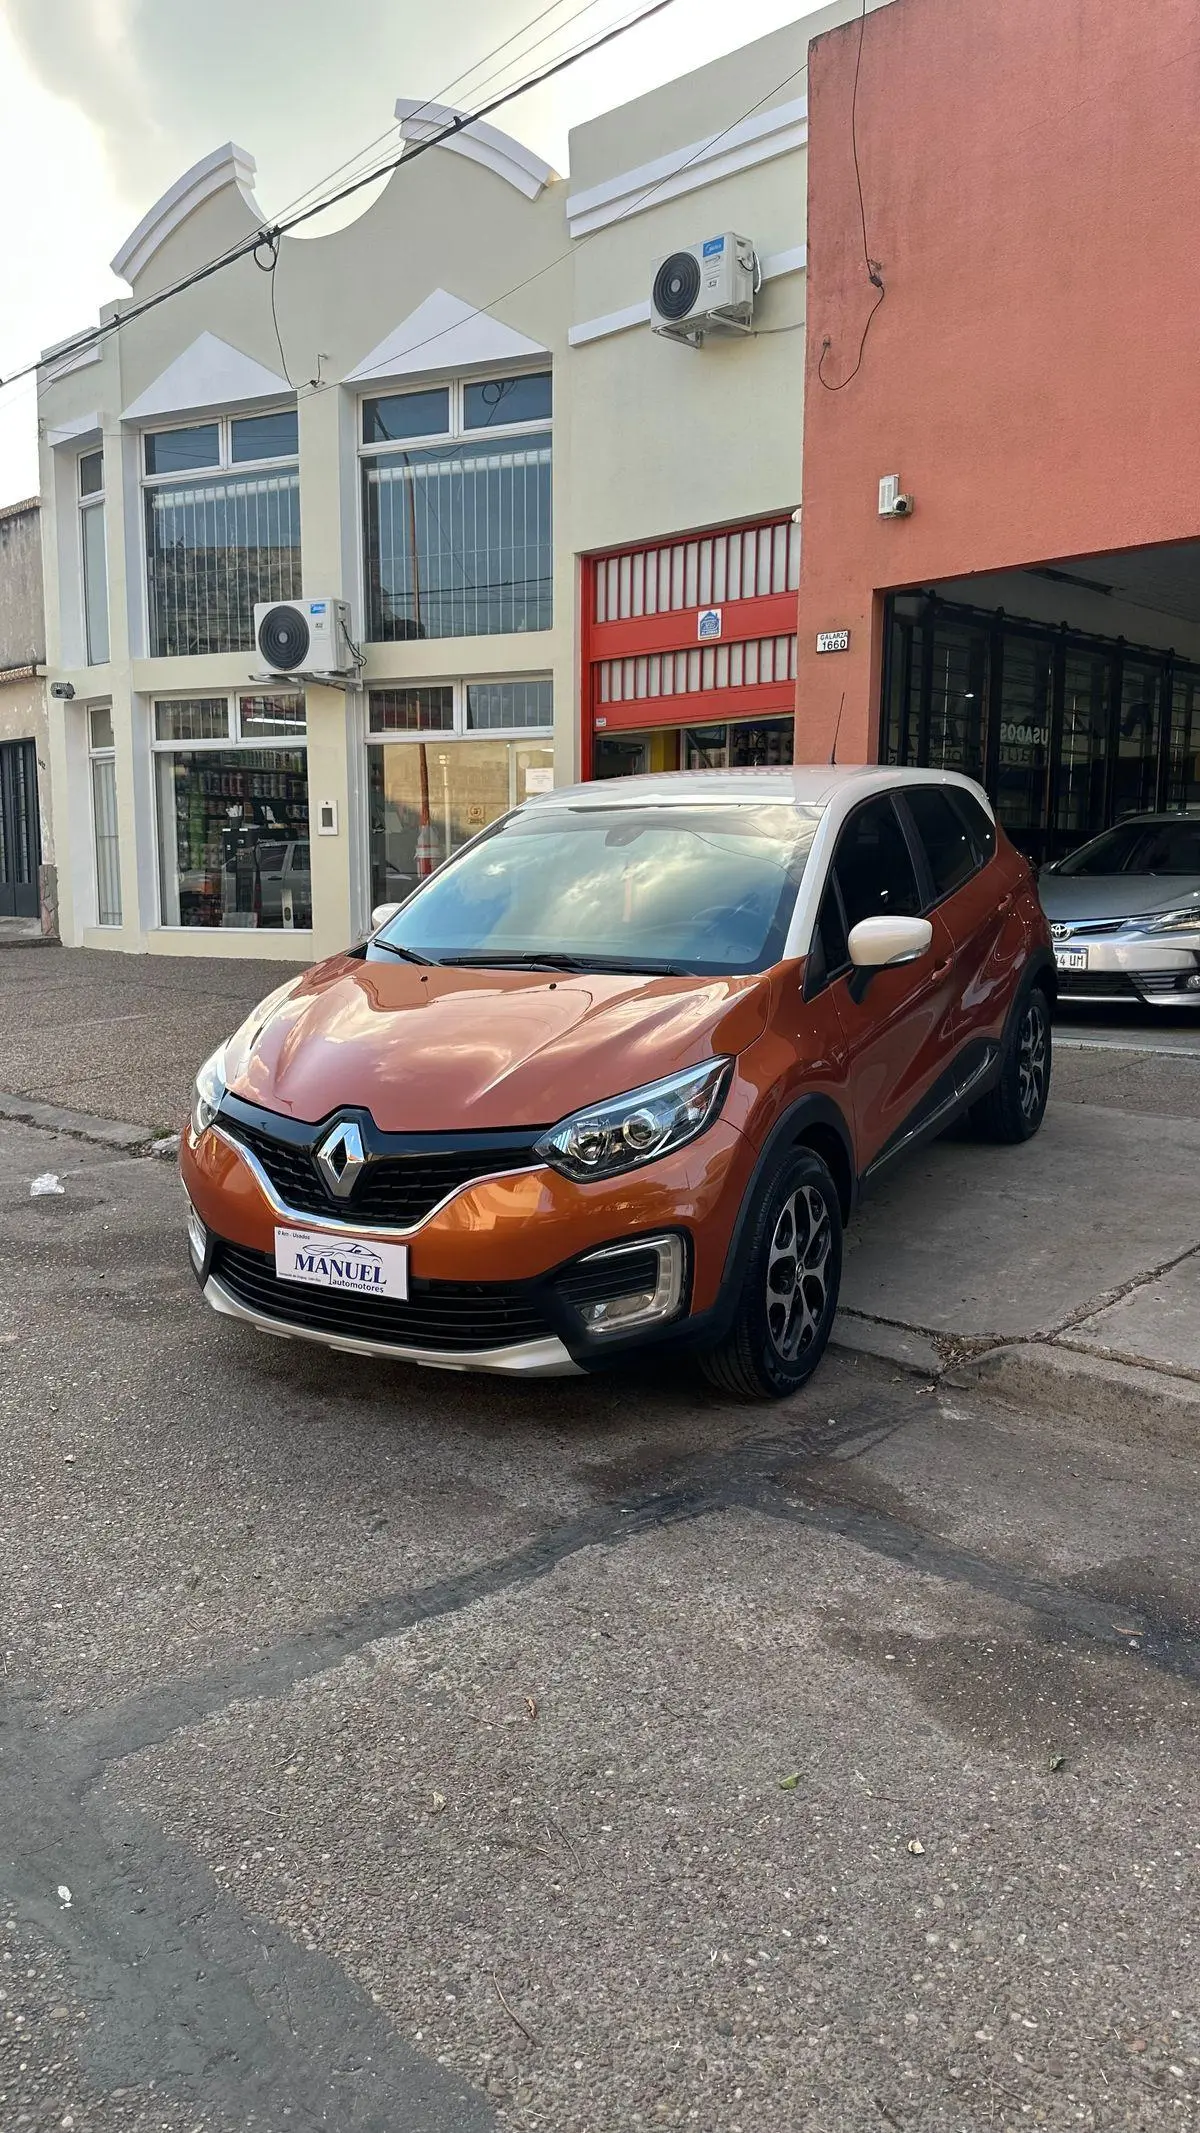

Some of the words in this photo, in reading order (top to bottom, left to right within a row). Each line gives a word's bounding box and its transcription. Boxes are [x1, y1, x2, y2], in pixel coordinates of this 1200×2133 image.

[820, 632, 848, 641] GALARZA
[823, 639, 846, 650] 1660
[292, 1232, 310, 1240] Usados
[294, 1253, 388, 1285] MANUEL
[332, 1279, 384, 1293] automotores
